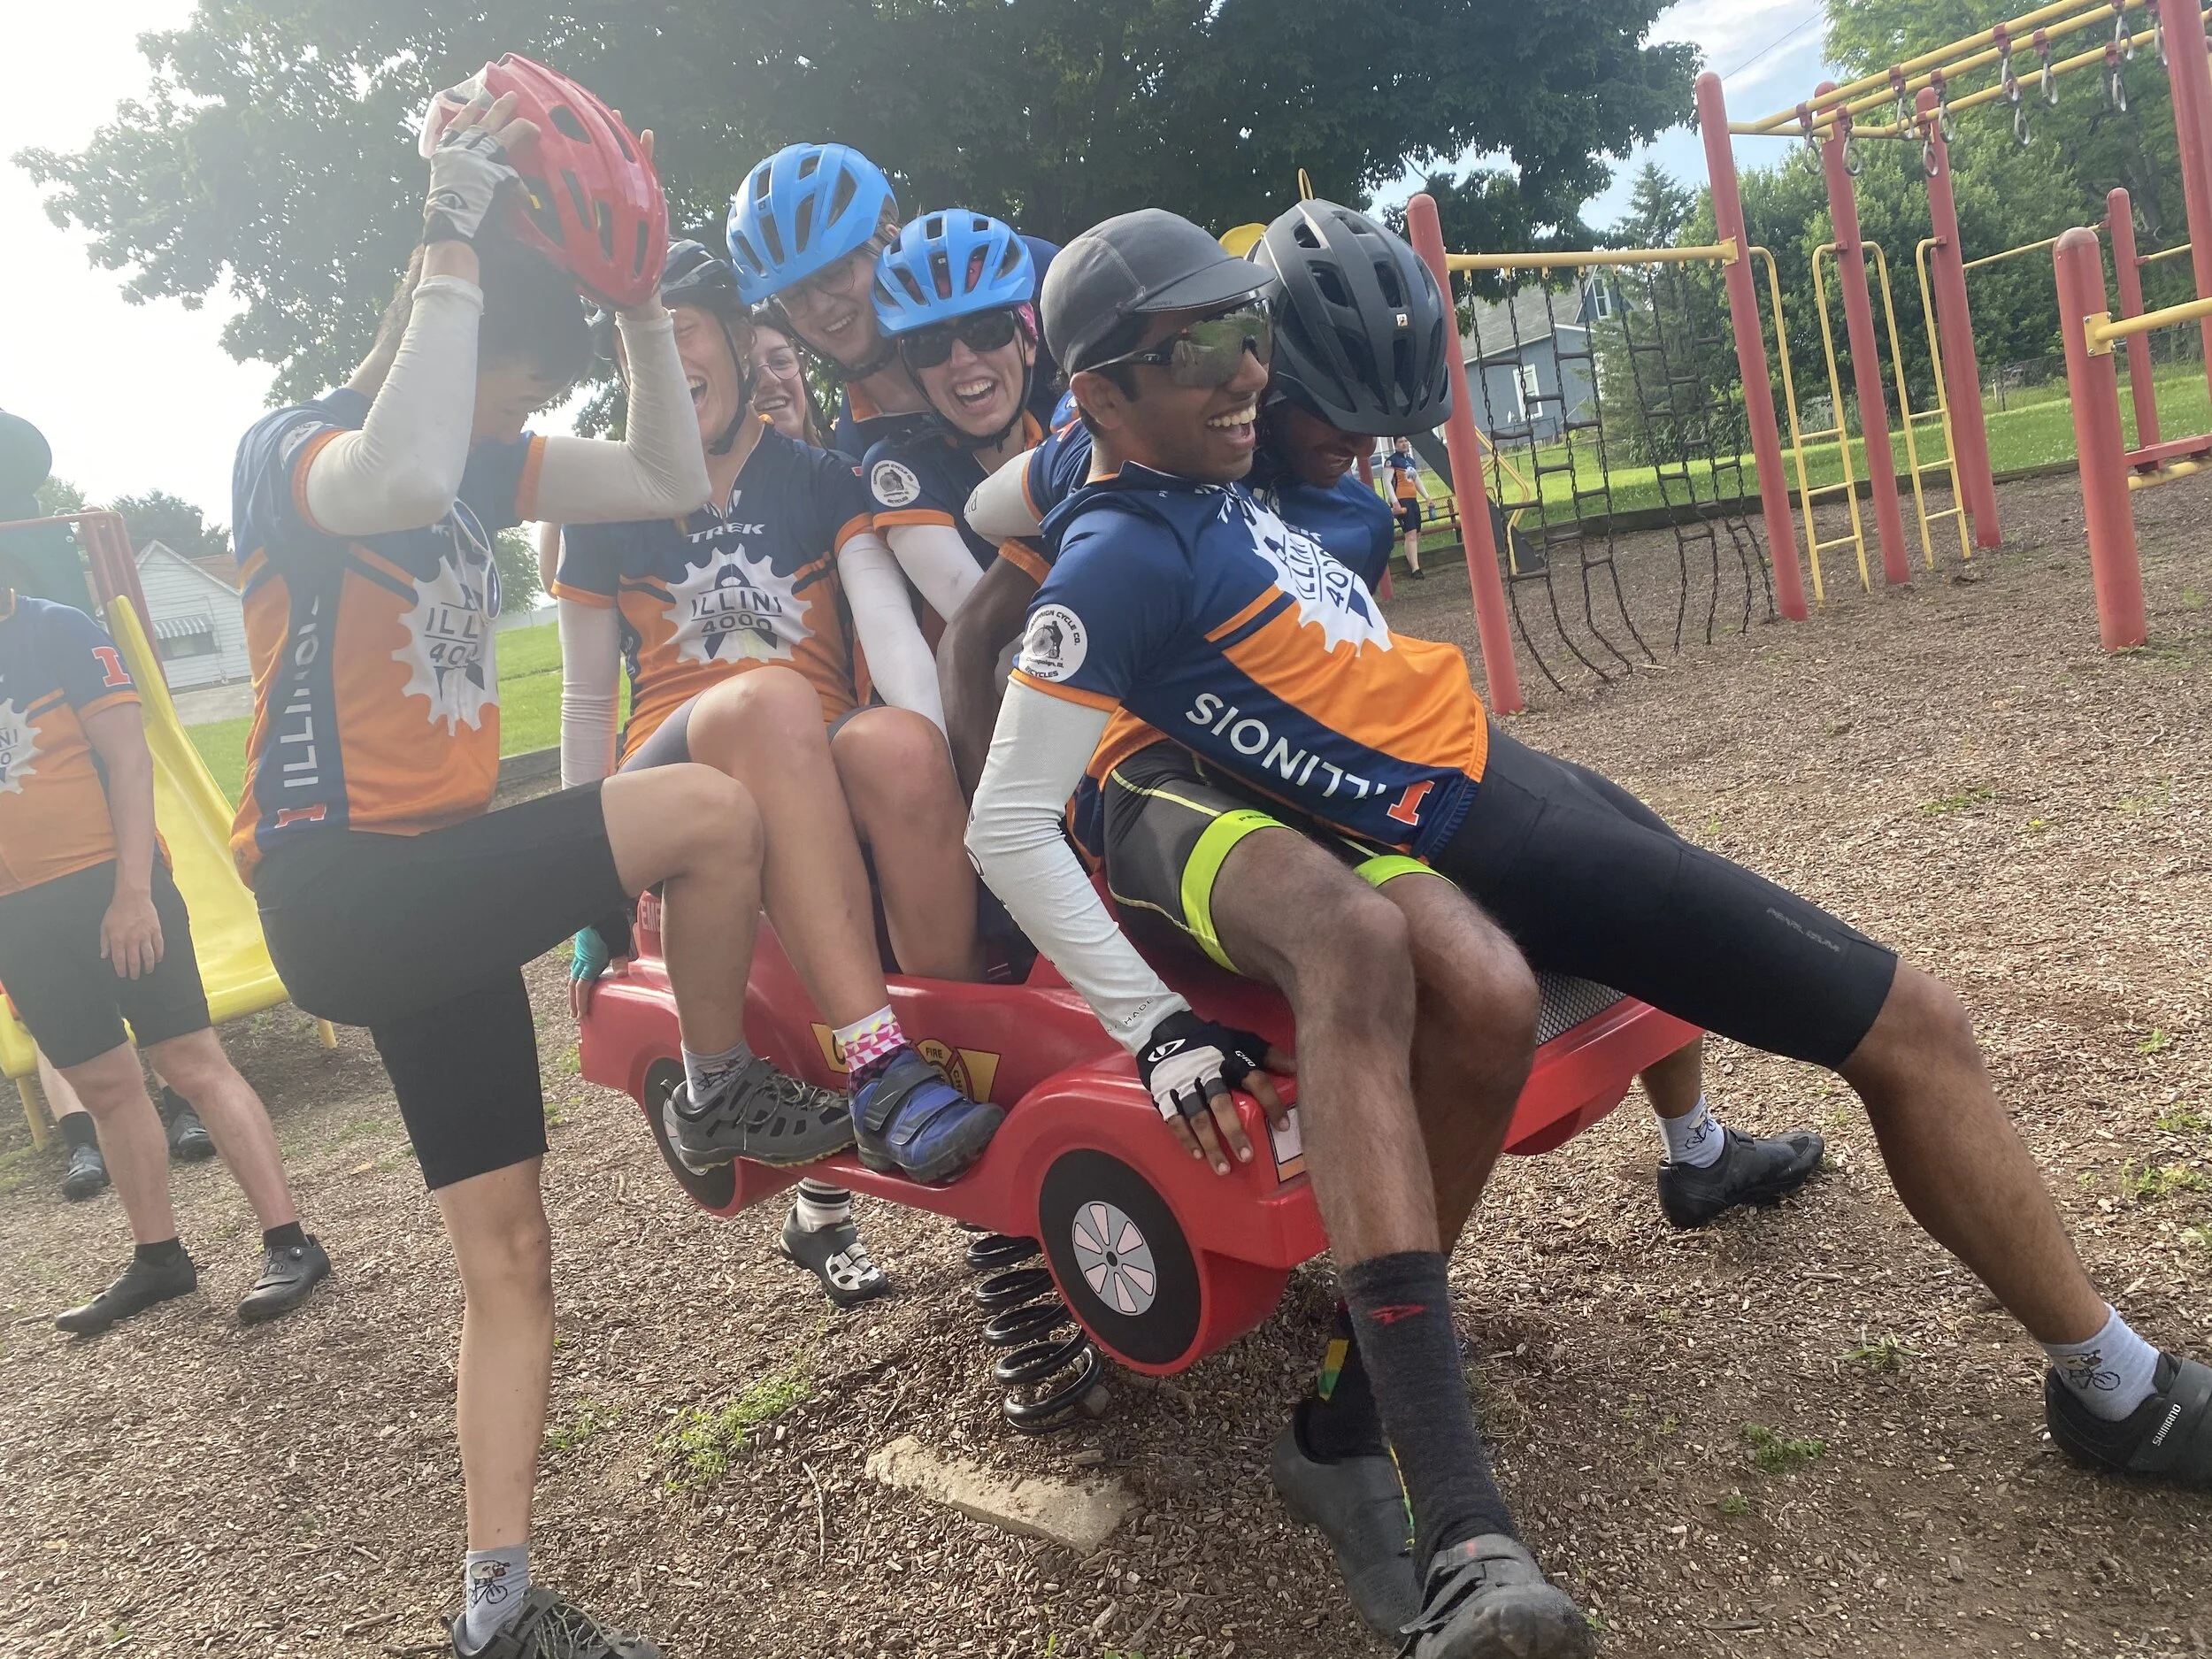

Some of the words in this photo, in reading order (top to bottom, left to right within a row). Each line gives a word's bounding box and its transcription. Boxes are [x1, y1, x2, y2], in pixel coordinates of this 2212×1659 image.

[686, 522, 765, 543] TREK
[691, 591, 782, 617] ILLINI
[701, 613, 772, 633] 4000
[1056, 611, 1077, 631] CYCLE
[1025, 665, 1059, 678] BICYCLES
[926, 1047, 943, 1059] FIRE
[1234, 1050, 1256, 1067] GIRO
[2152, 1403, 2182, 1447] SHIMANO
